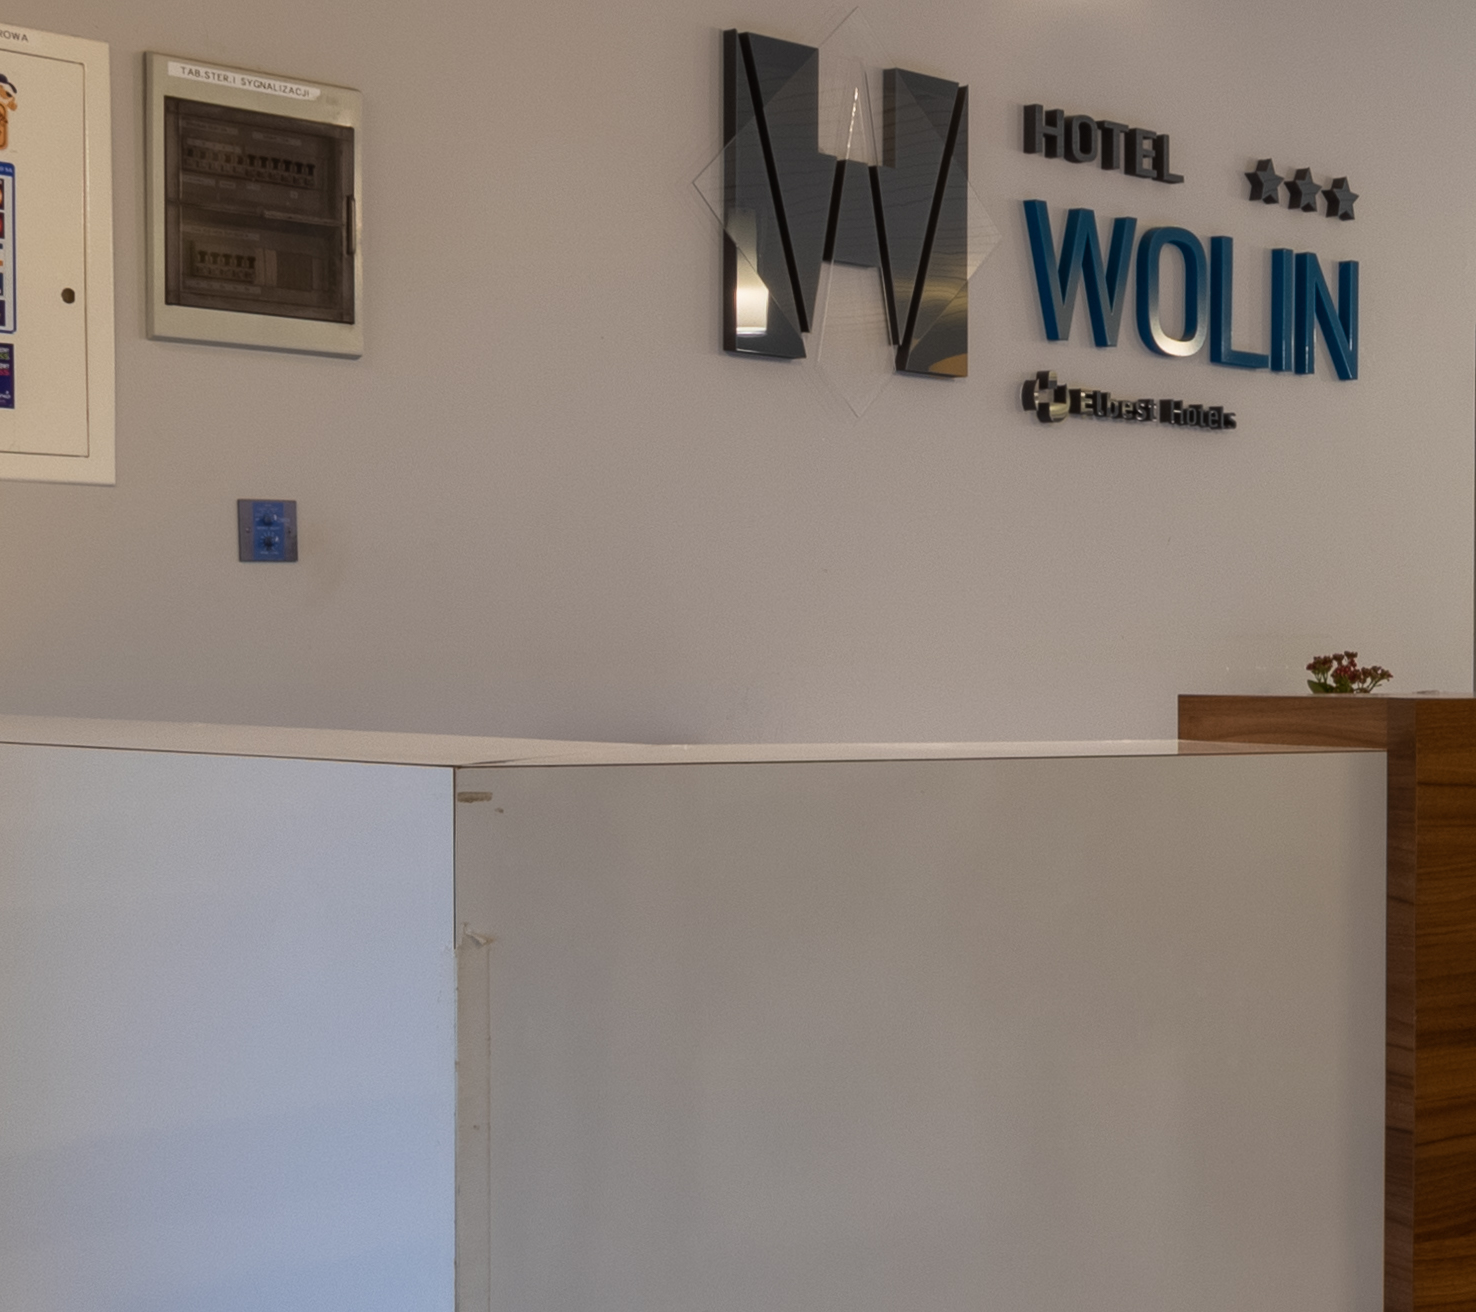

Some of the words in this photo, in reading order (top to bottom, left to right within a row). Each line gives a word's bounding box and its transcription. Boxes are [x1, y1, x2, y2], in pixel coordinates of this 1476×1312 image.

[1023, 103, 1184, 184] HOTEL
[1023, 199, 1359, 380] WOLIN
[1069, 389, 1158, 424] Elbest
[1159, 396, 1237, 431] Hotels
